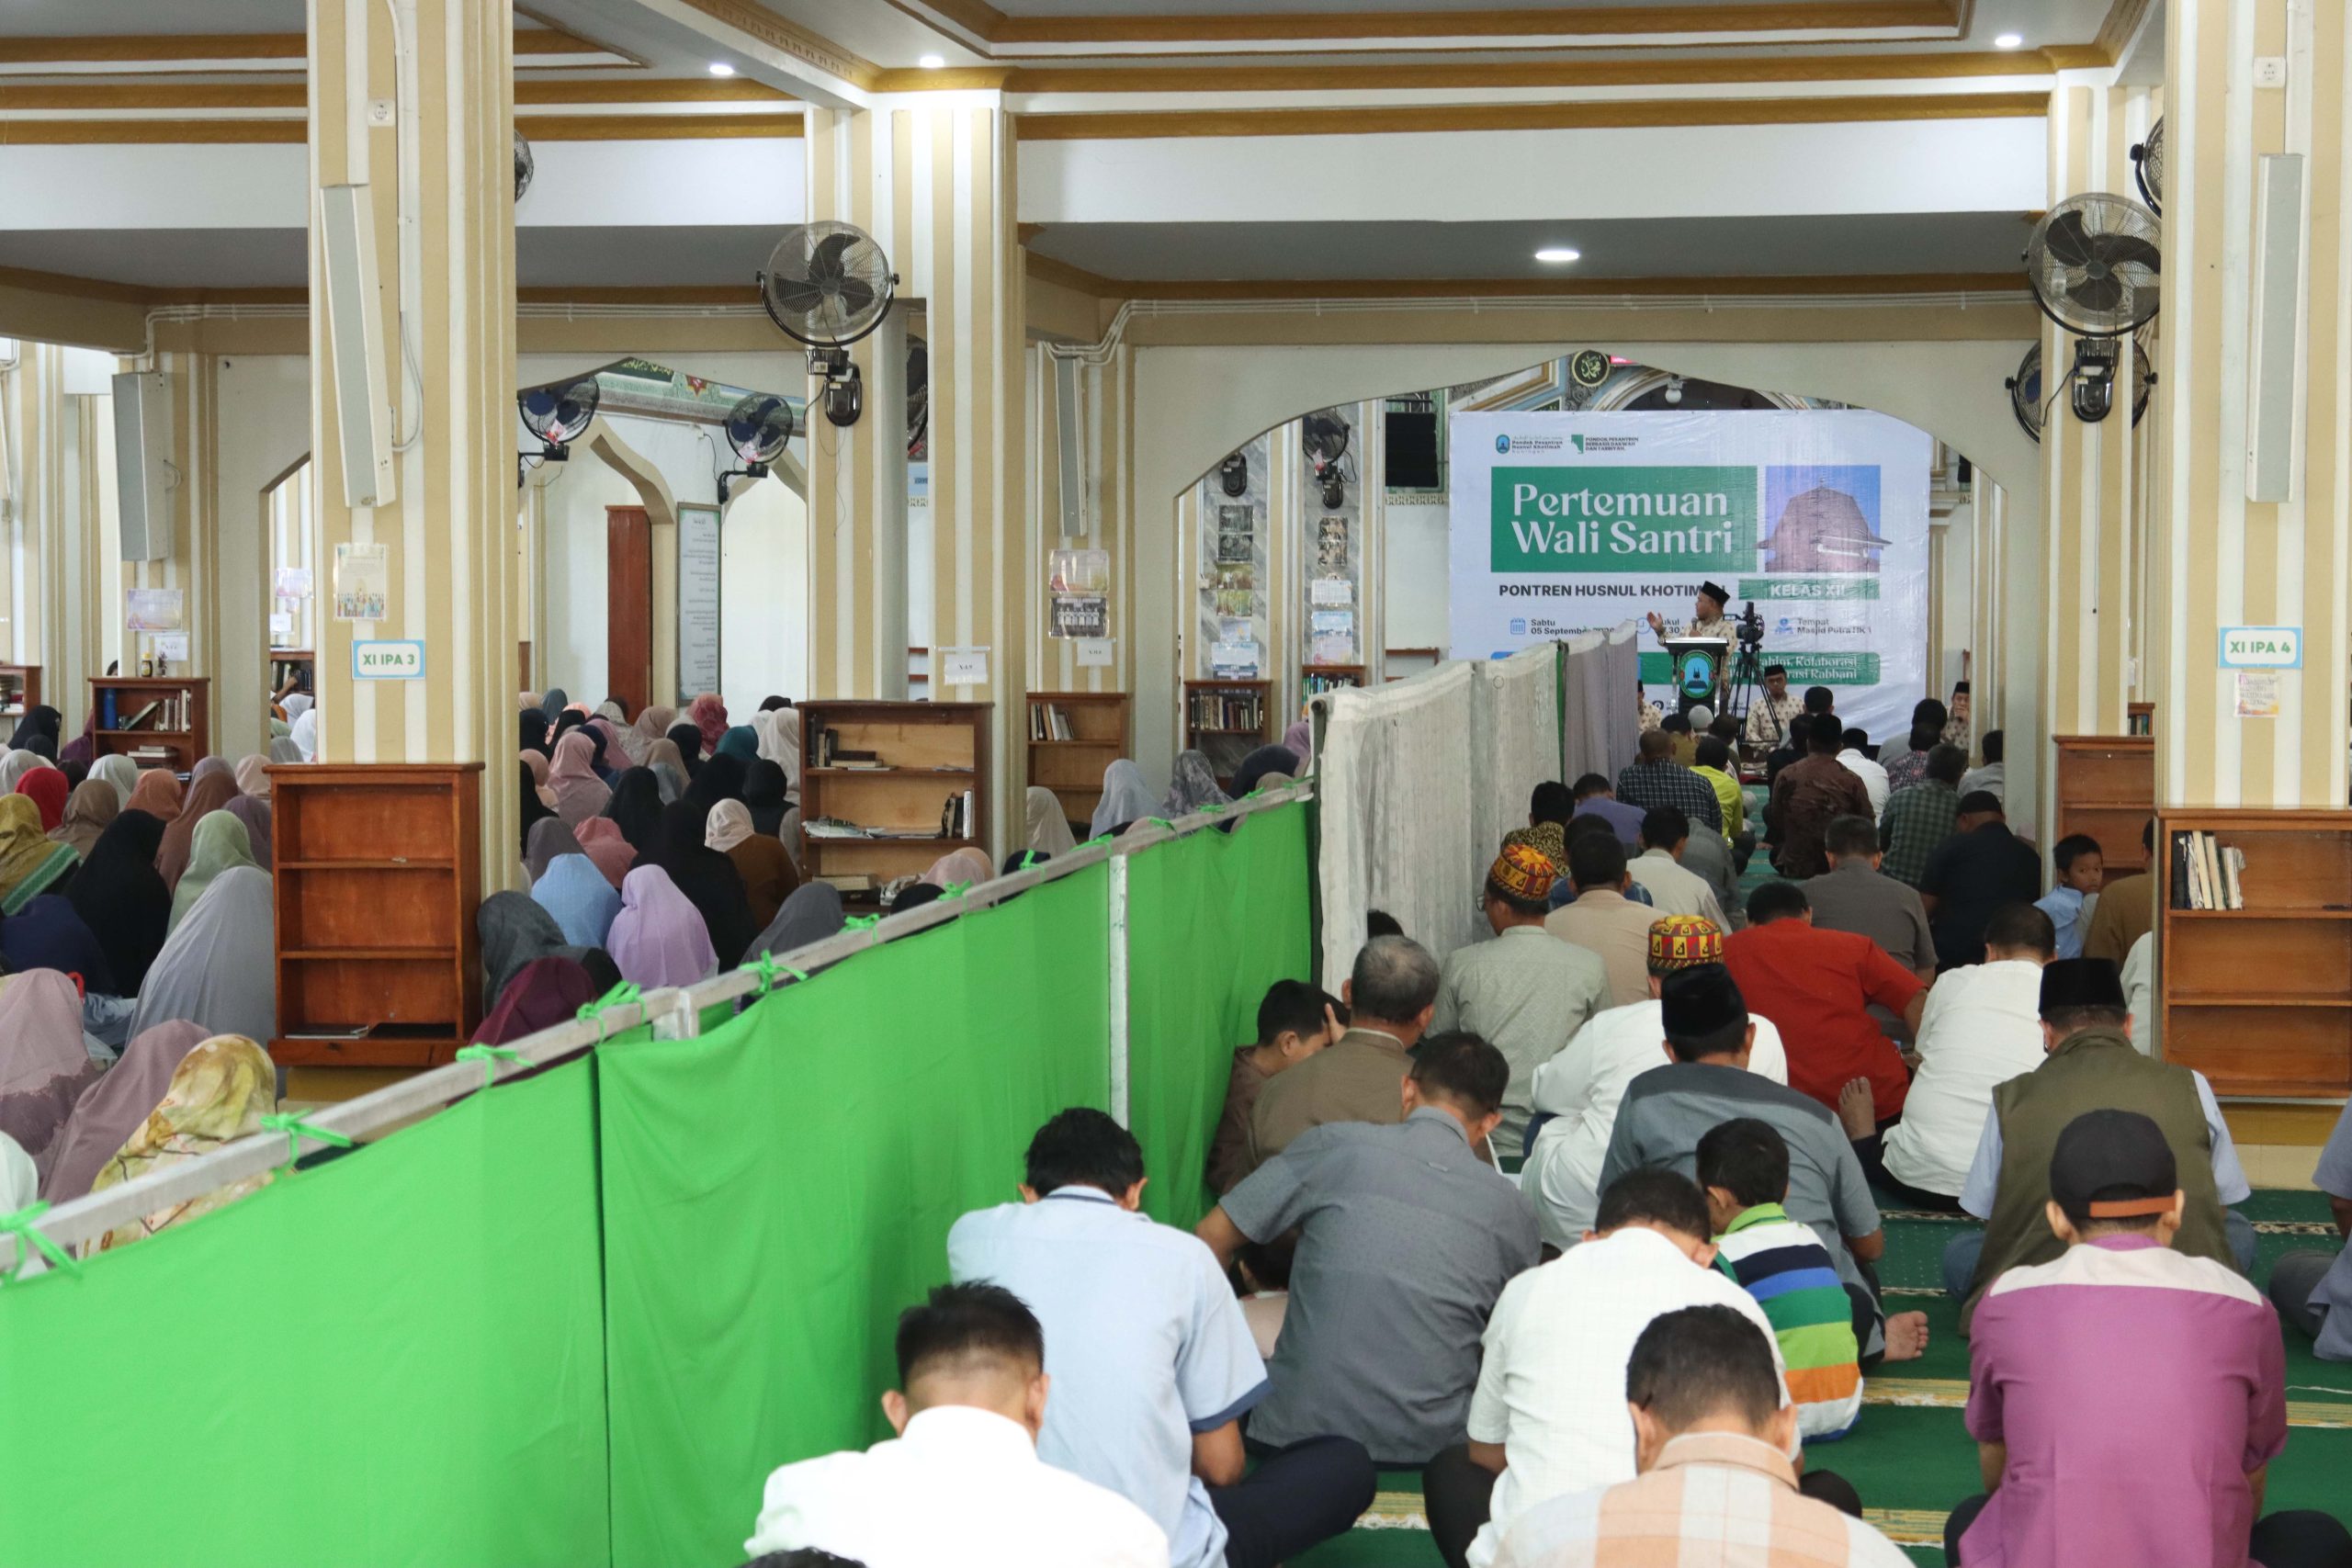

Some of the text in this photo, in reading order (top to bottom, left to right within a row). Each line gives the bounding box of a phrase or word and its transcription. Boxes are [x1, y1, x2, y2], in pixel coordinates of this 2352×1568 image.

[1514, 483, 1727, 516] Pertemuan
[1511, 520, 1732, 554] Wali Santri
[1499, 584, 1725, 596] PONTREN HUSNUL KHOTIM
[1771, 584, 1845, 596] KELAS XII
[1798, 617, 1829, 627] Tempat
[1531, 626, 1543, 635] 05
[1797, 626, 1826, 635] Masjid
[2230, 641, 2291, 653] XI IPA 4
[363, 654, 415, 666] XI IPA 3
[1796, 656, 1857, 667] Kolaborasi
[1811, 669, 1857, 679] Rabbani
